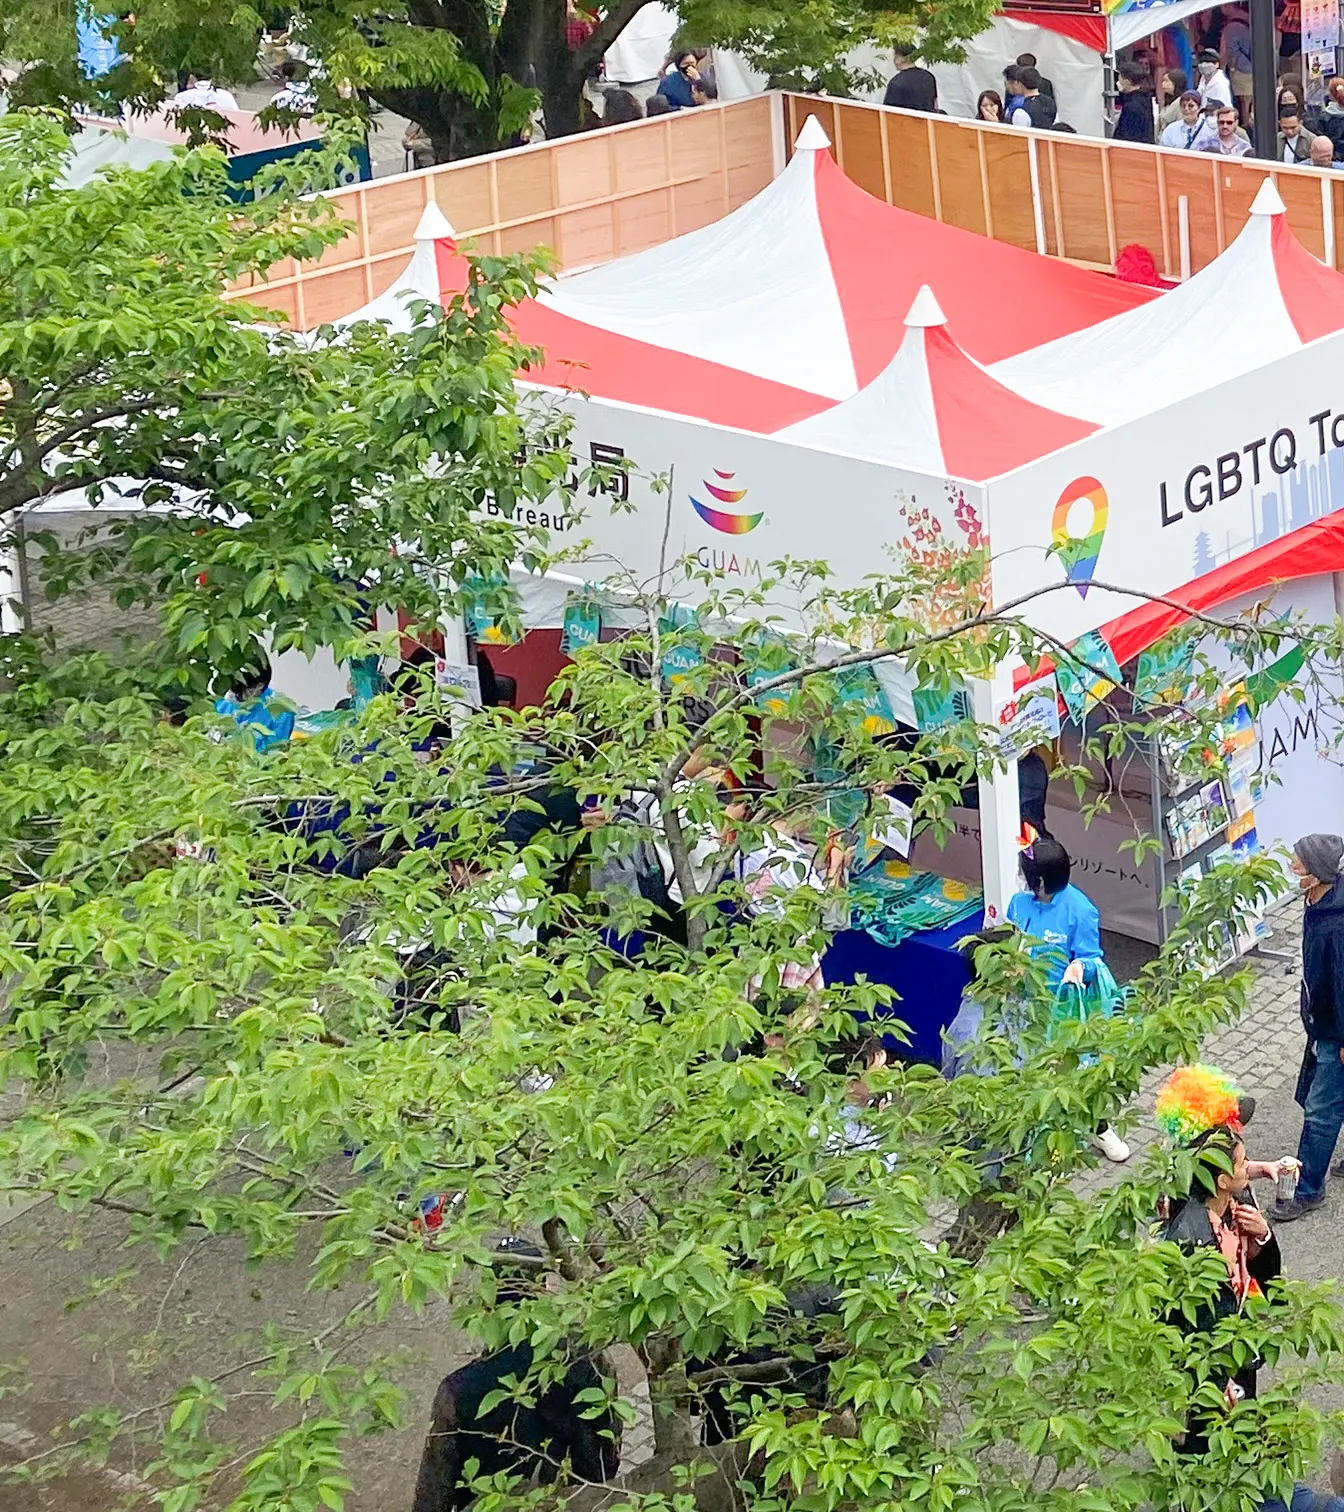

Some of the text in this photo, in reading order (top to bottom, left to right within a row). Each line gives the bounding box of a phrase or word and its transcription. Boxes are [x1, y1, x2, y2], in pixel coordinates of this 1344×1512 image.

[1159, 425, 1298, 528] LGBTQ
[486, 495, 567, 532] Breau
[697, 545, 763, 580] GUAM
[568, 622, 597, 641] GUA
[1256, 708, 1319, 773] UAM
